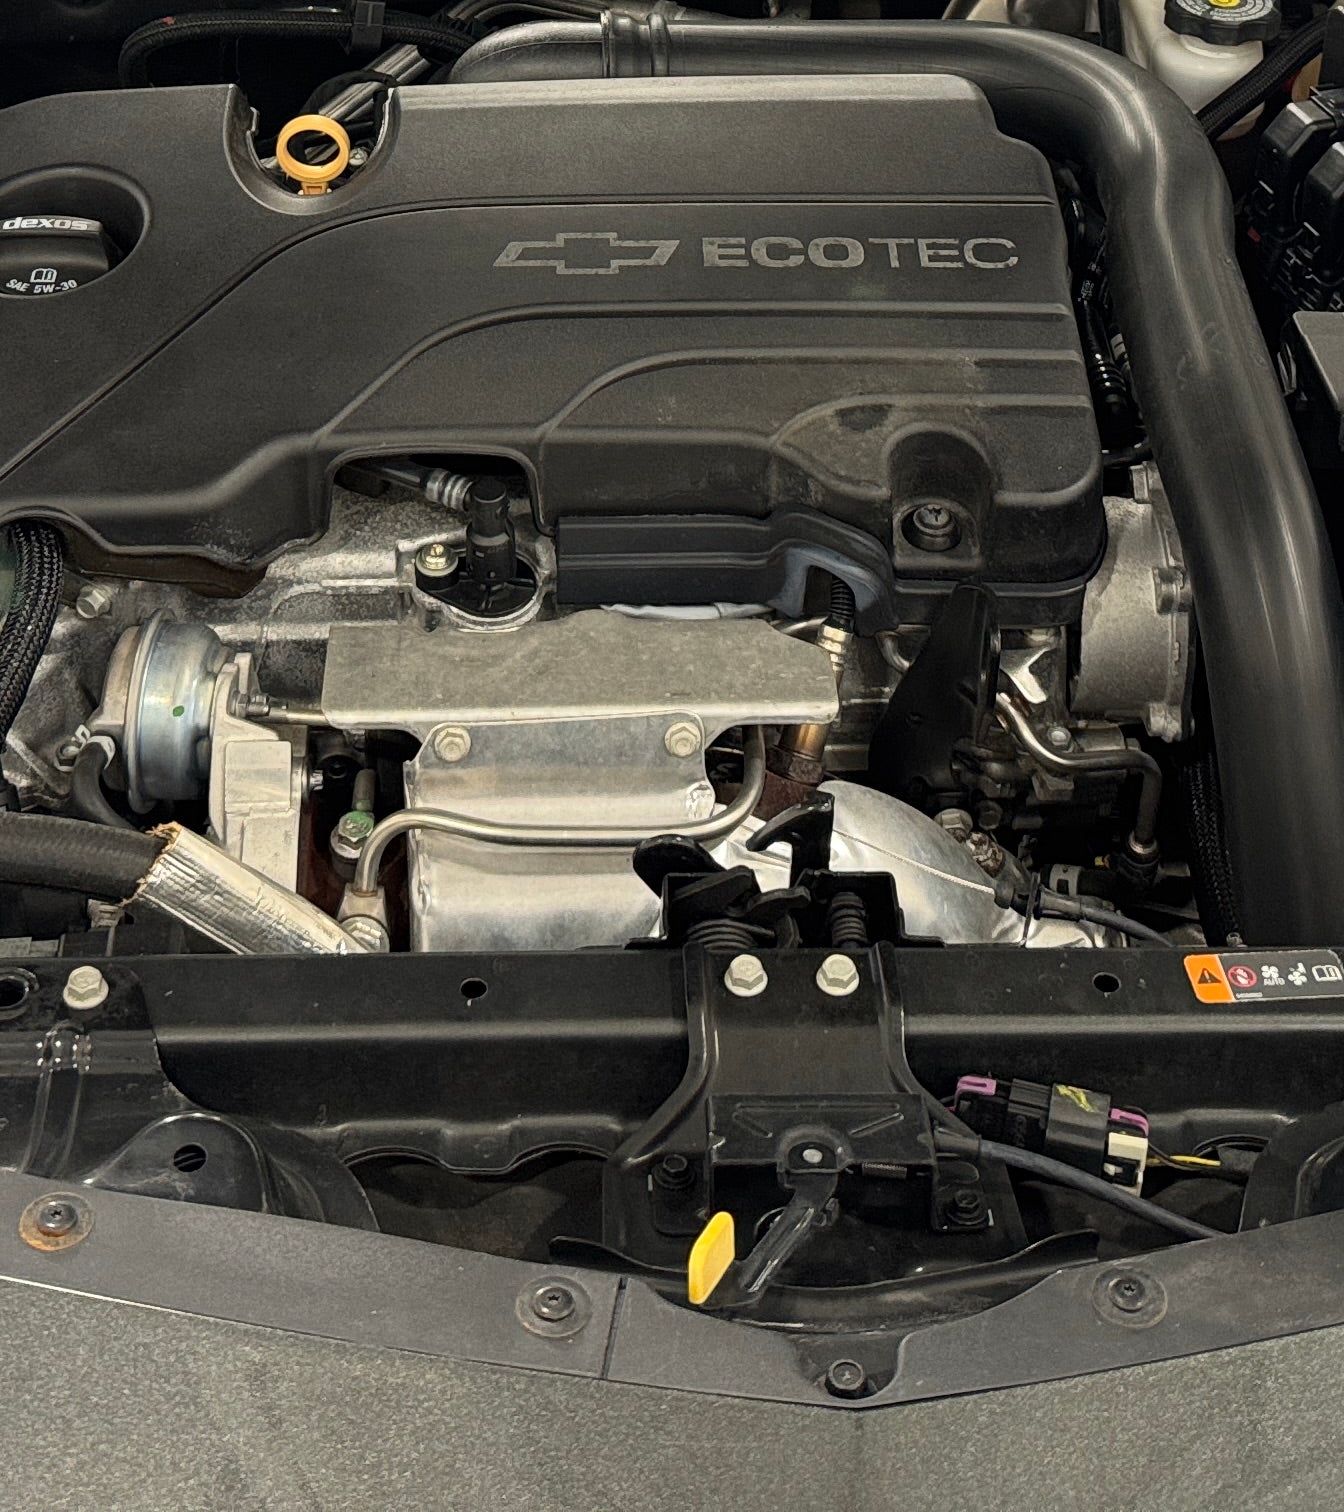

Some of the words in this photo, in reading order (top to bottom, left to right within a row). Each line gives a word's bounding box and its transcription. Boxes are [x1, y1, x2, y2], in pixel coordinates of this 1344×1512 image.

[2, 216, 89, 231] dexos
[702, 236, 1019, 270] ECOTEC
[5, 278, 31, 292] SAE
[33, 279, 78, 294] 5W-30
[1263, 977, 1286, 986] AUTO
